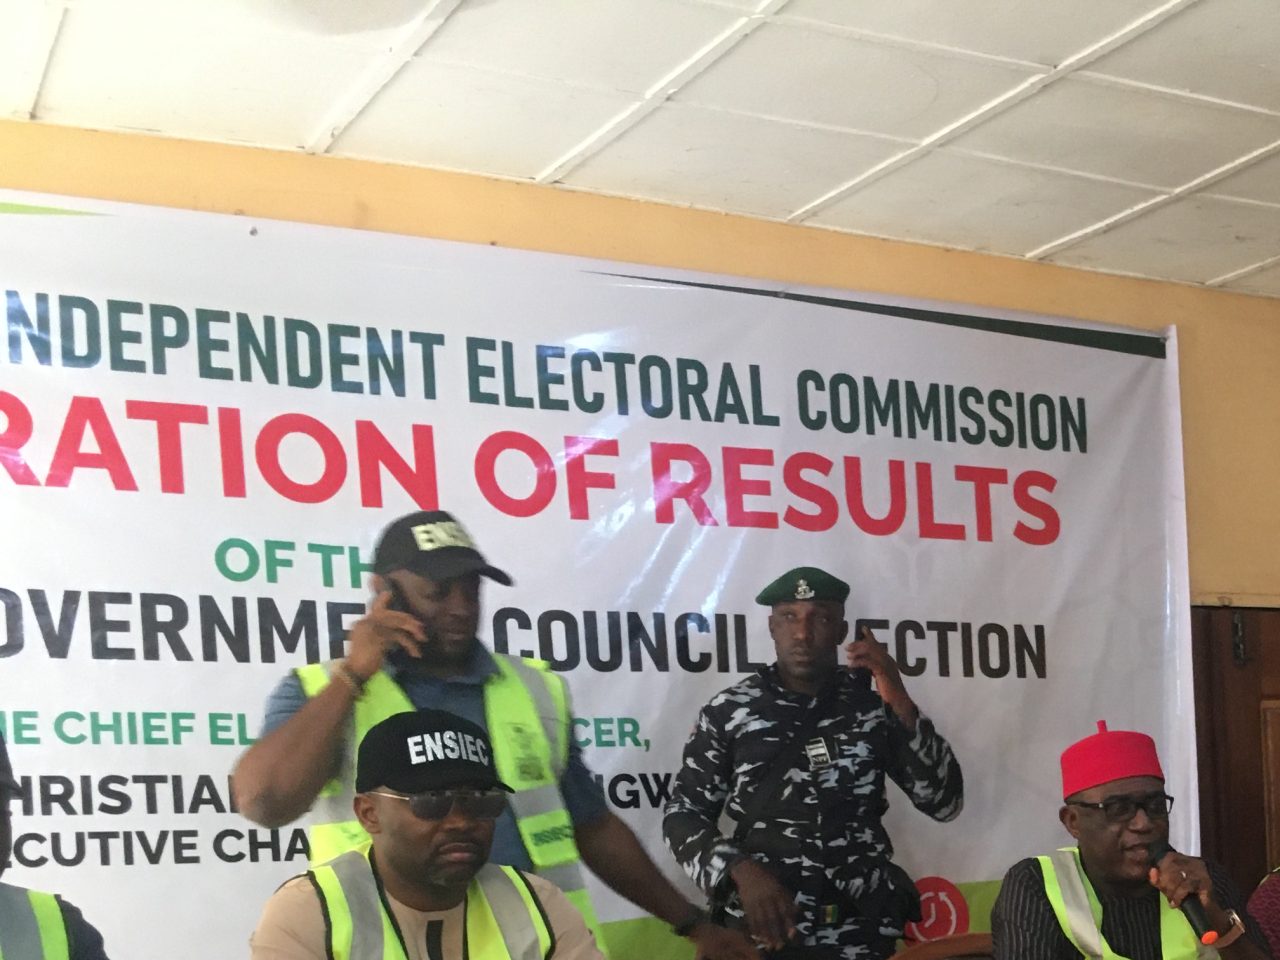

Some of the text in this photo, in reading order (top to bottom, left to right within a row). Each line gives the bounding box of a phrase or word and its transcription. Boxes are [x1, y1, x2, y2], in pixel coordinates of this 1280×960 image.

[0, 290, 1088, 454] NDEPENDENT ELECTORAL COMMISSION
[474, 431, 619, 520] OF
[650, 441, 1061, 545] RESULTS
[214, 537, 376, 589] OF TH
[492, 606, 768, 674] COUNCIL
[840, 618, 1047, 679] ECTION
[54, 711, 196, 745] CHIEF
[208, 713, 258, 746] EL
[571, 717, 650, 752] CER,
[407, 730, 488, 766] ENSIEC
[5, 828, 312, 868] CUTIVE CHA
